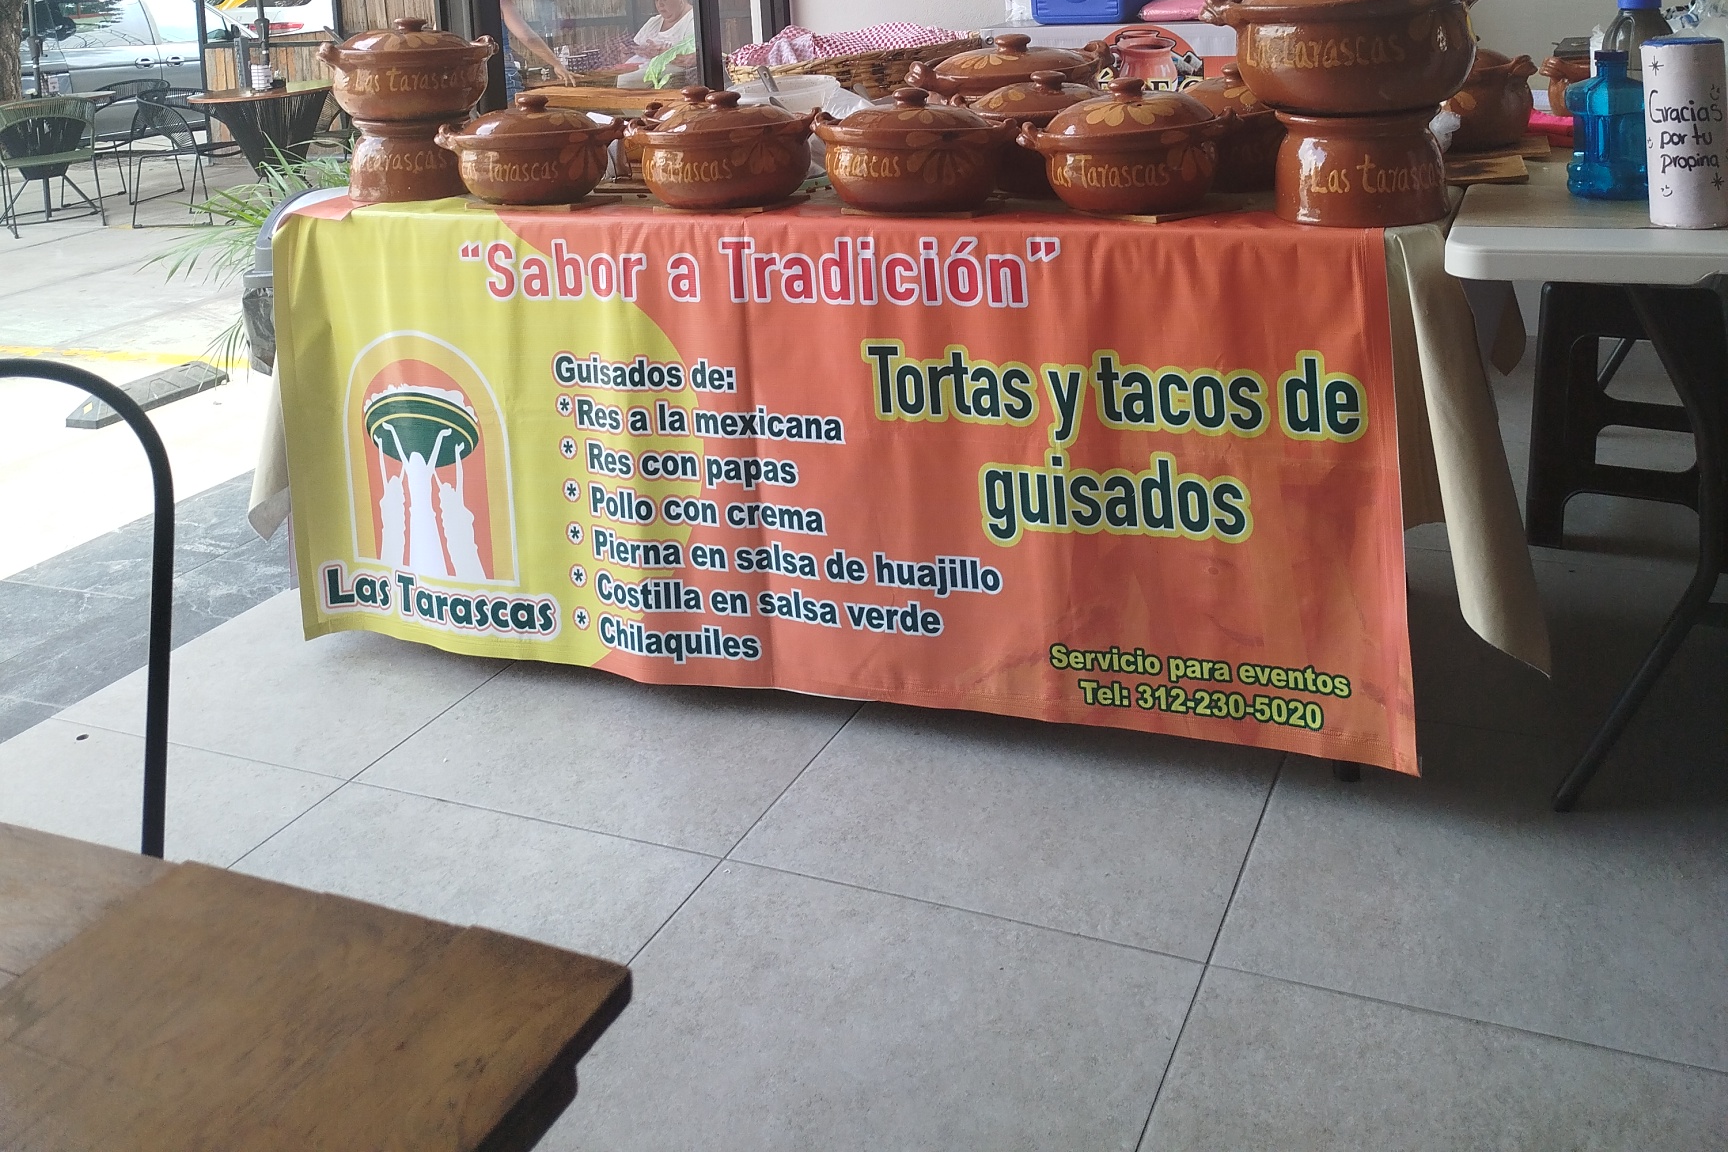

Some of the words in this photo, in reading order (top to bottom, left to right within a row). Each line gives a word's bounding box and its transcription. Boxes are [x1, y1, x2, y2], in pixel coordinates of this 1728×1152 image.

[1649, 89, 1722, 124] Gracias
[1660, 130, 1687, 149] por
[1692, 124, 1712, 146] tu
[1660, 148, 1720, 174] propina
[1310, 164, 1350, 194] Las
[668, 256, 701, 303] a
[554, 352, 685, 388] Guisados
[690, 358, 737, 392] de:
[865, 343, 1035, 421] Tortas
[1046, 368, 1082, 443] y
[1095, 354, 1265, 433] tacos
[1283, 355, 1364, 437] de
[575, 398, 622, 430] Res
[628, 409, 651, 434] a
[655, 401, 689, 435] la
[694, 405, 846, 444] mexicana
[586, 440, 634, 478] Res
[640, 451, 699, 479] con
[704, 456, 798, 490] papas
[590, 482, 656, 523] Pollo
[663, 498, 720, 527] con
[726, 501, 827, 536] crema
[983, 452, 1248, 542] guisados
[592, 526, 682, 568] Pierna
[691, 544, 728, 572] en
[736, 541, 819, 581] salsa
[825, 550, 869, 583] de
[874, 552, 1003, 598] huajillo
[324, 564, 391, 610] Las
[394, 570, 558, 636] Tarascas
[595, 571, 704, 613] Costilla
[711, 590, 750, 617] en
[757, 589, 841, 628] salsa
[847, 600, 944, 637] verde
[599, 613, 762, 664] Chilaquiles
[1050, 643, 1162, 676] Servicio
[1168, 656, 1231, 682] para
[1239, 662, 1351, 698] eventos
[1078, 679, 1130, 708] Tel:
[1136, 684, 1324, 730] 312-230-5020
